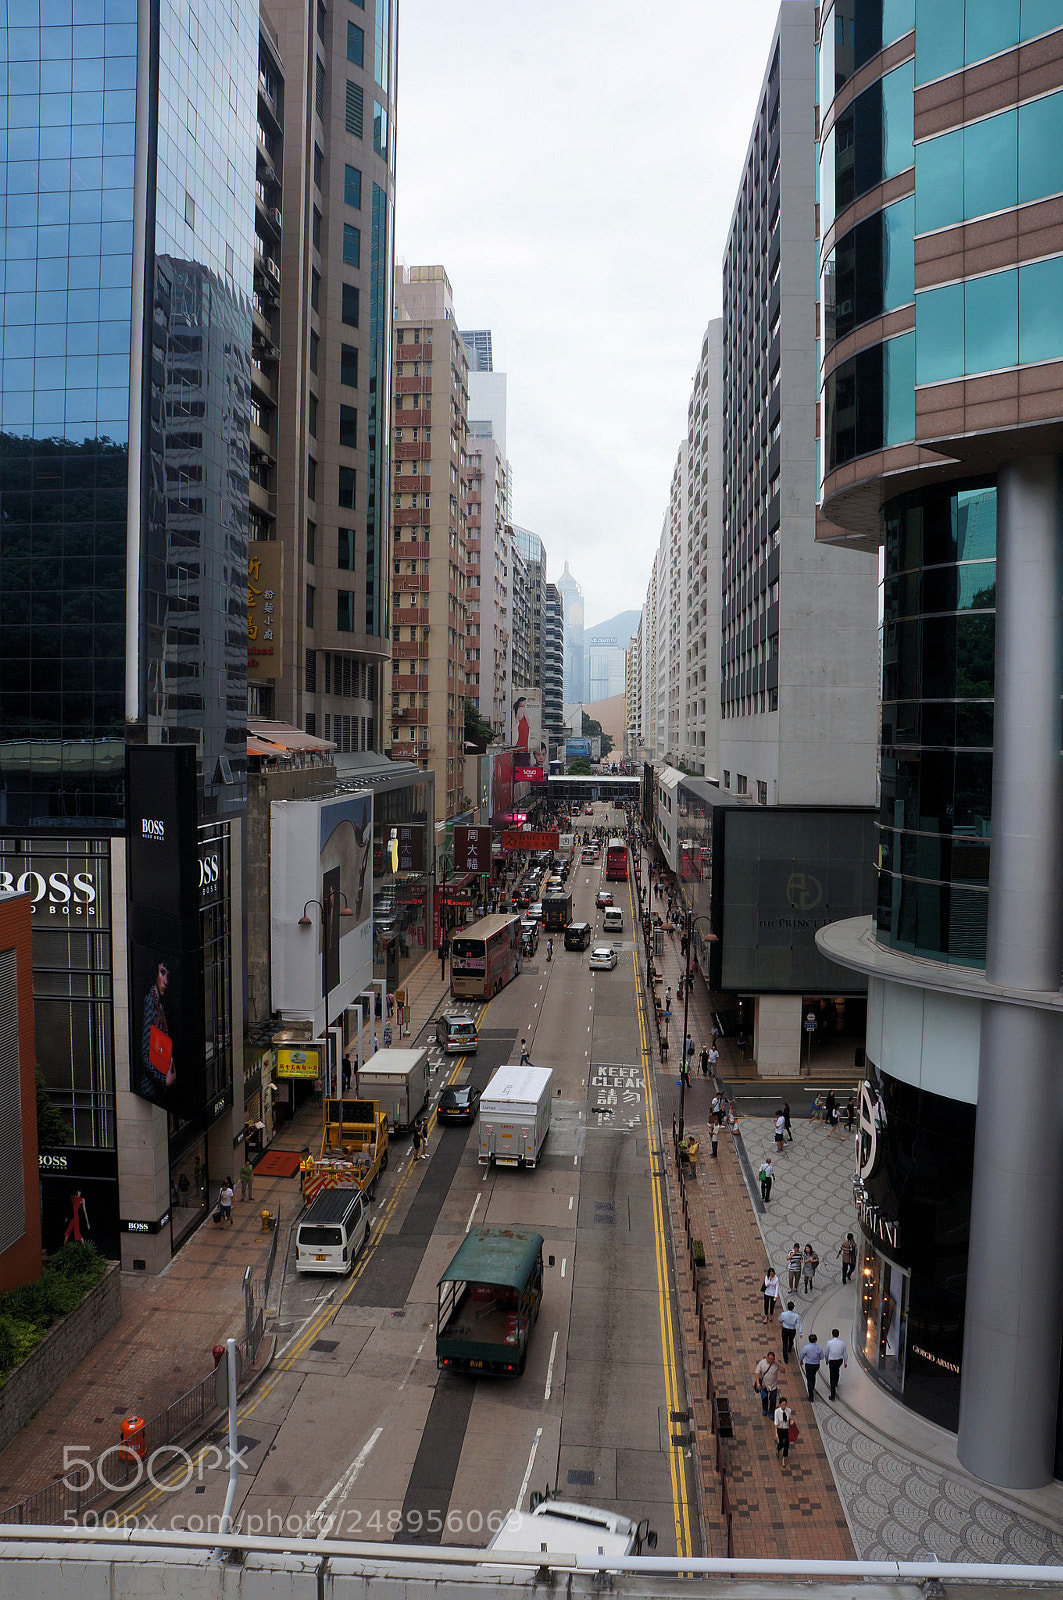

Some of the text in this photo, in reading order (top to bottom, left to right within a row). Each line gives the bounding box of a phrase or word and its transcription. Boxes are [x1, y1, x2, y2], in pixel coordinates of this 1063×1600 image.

[247, 646, 274, 656] sland
[142, 818, 165, 836] BOSS
[466, 829, 479, 870] 周大福
[198, 854, 219, 887] OSS
[49, 905, 95, 915] BOSS
[779, 918, 818, 928] PRINCE
[597, 1066, 640, 1078] KEEP
[591, 1076, 646, 1089] CLEAR
[597, 1088, 641, 1107] 請勿
[128, 1222, 149, 1230] BOSS
[912, 1344, 960, 1374] GIORGIO ARMANI
